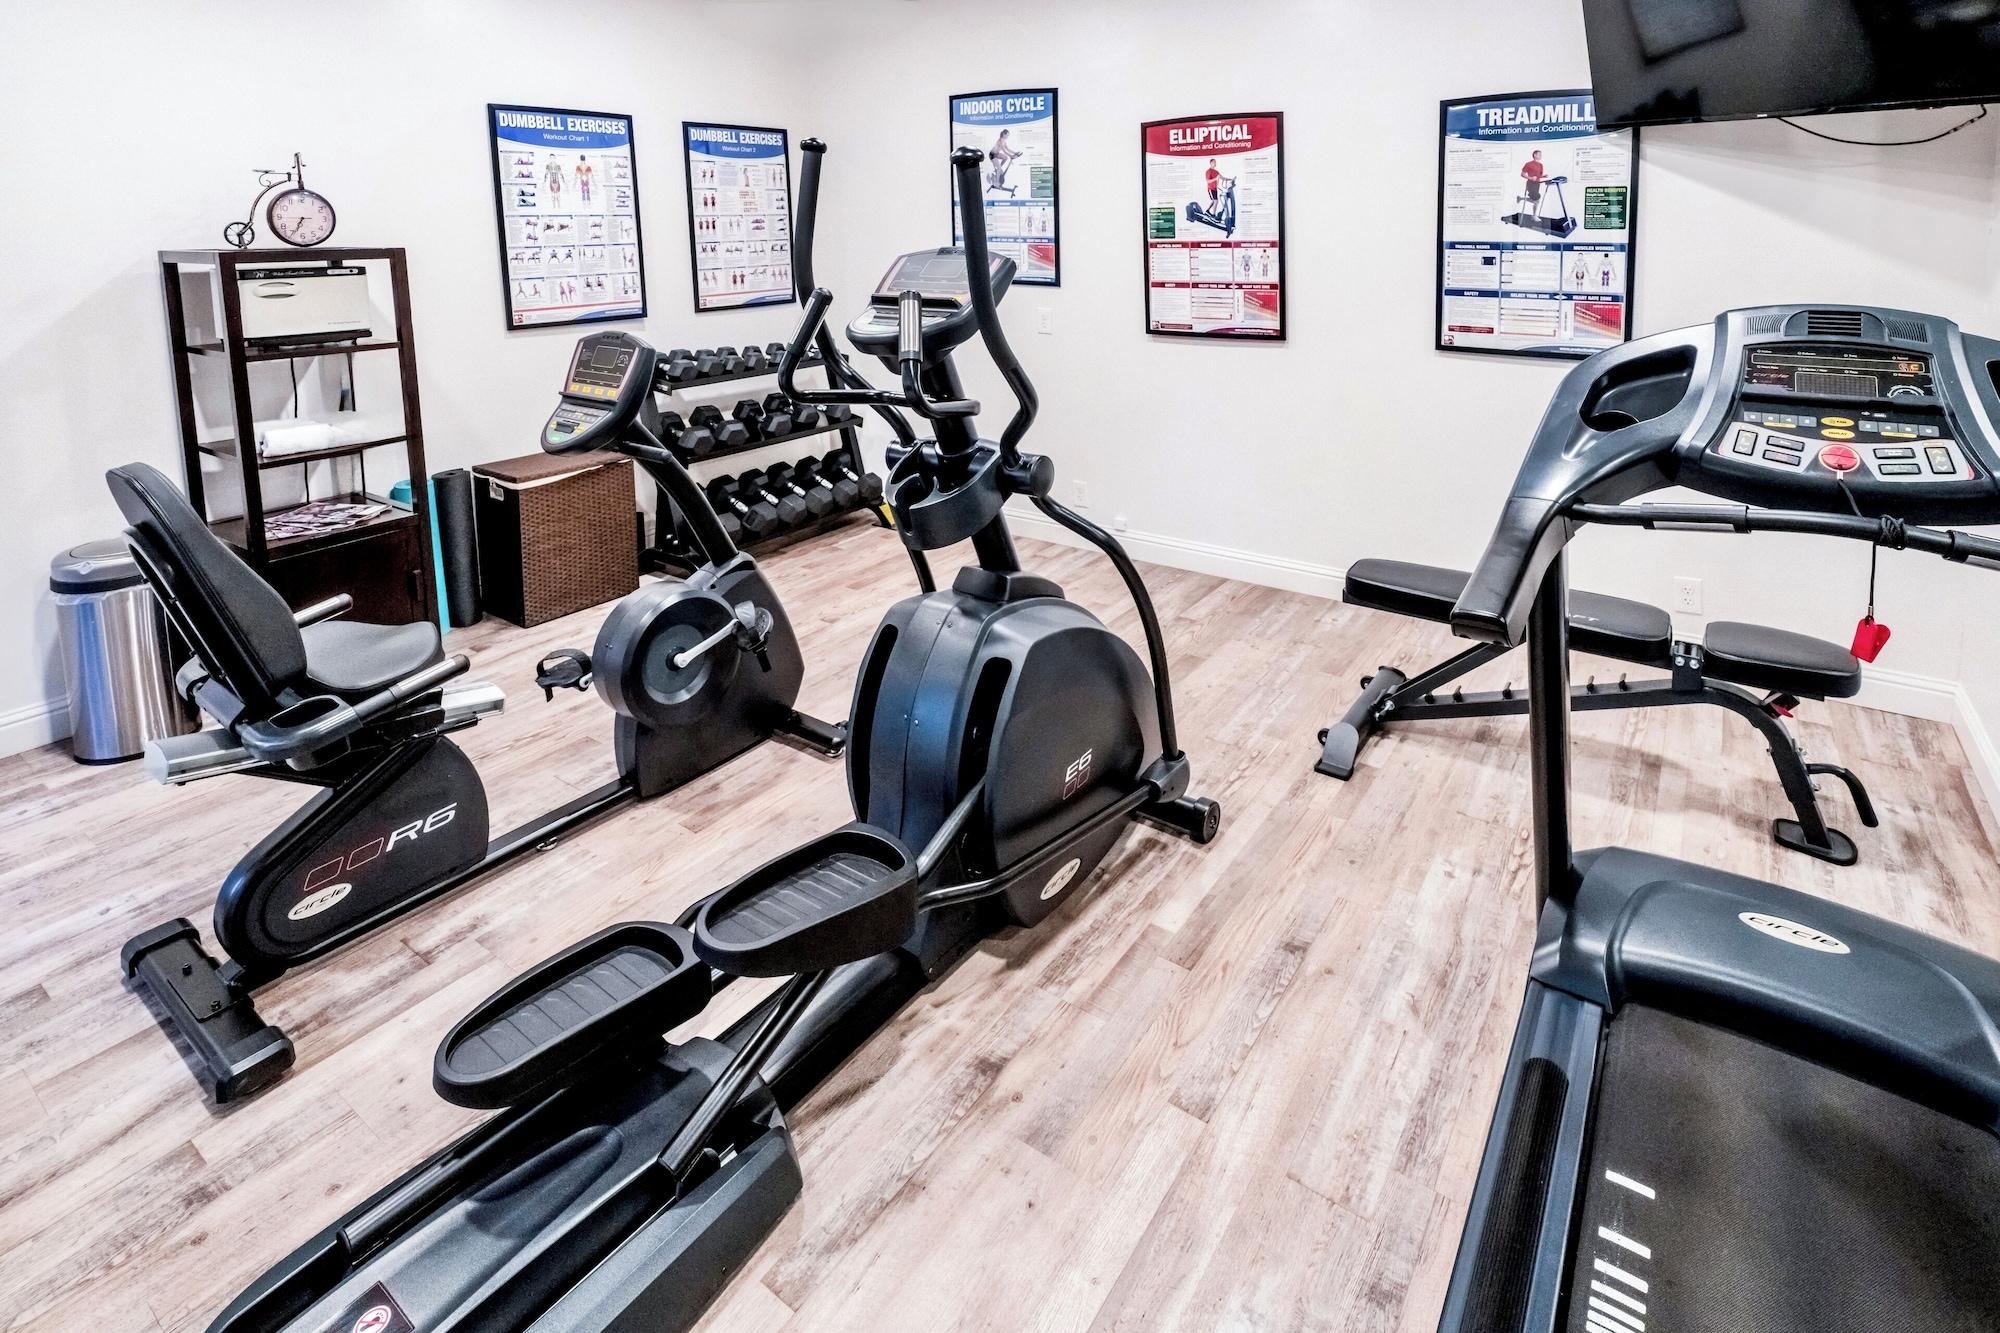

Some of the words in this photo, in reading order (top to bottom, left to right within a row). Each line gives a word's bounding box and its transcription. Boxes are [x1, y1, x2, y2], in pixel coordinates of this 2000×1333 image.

[960, 99, 1002, 115] INDOOR
[1006, 96, 1045, 112] CYCLE
[1477, 103, 1596, 127] TREADMILL
[499, 113, 564, 131] DUMBBELL
[567, 118, 626, 135] EXERCISES
[1169, 124, 1252, 145] ELLIPTICAL
[1479, 126, 1522, 136] Information
[1524, 125, 1540, 134] and
[1542, 124, 1594, 133] Conditioning
[690, 129, 738, 143] DUMBBELL
[740, 132, 783, 146] EXERCISES
[1170, 144, 1201, 152] Information
[1214, 141, 1252, 149] Conditioning
[1064, 748, 1093, 782] E6
[386, 802, 458, 853] R6
[1043, 862, 1078, 895] circle
[293, 885, 347, 916] circle
[1749, 917, 1839, 947] circle
